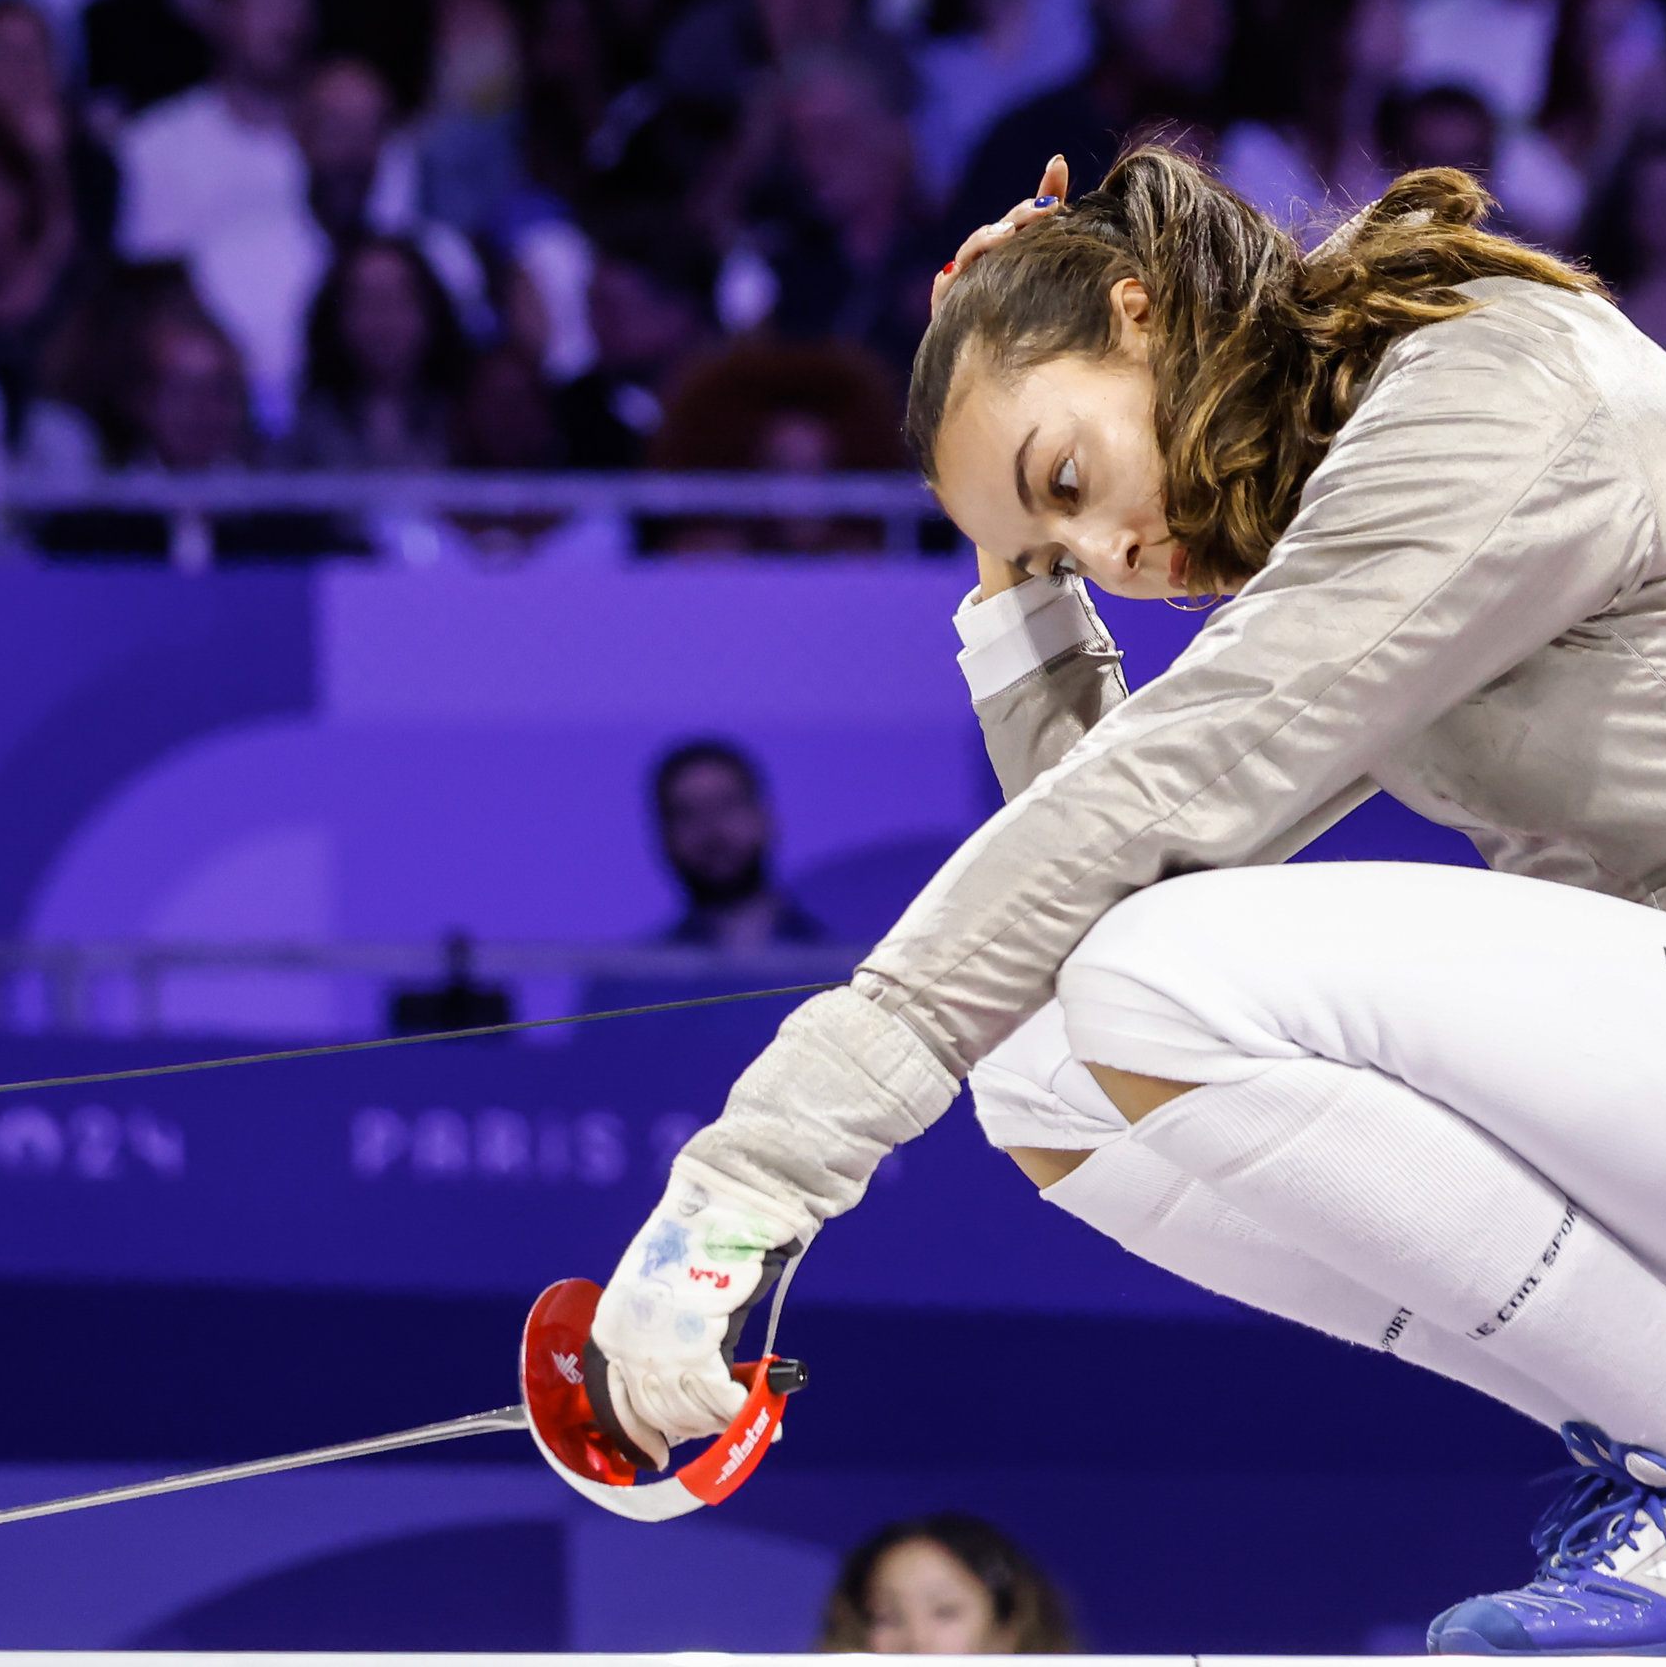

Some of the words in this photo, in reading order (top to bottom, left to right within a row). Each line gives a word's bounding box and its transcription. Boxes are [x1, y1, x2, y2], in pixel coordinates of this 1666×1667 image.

[351, 1106, 627, 1184] PARIS
[1542, 1202, 1578, 1268] SPOR
[719, 1405, 771, 1480] allstar
